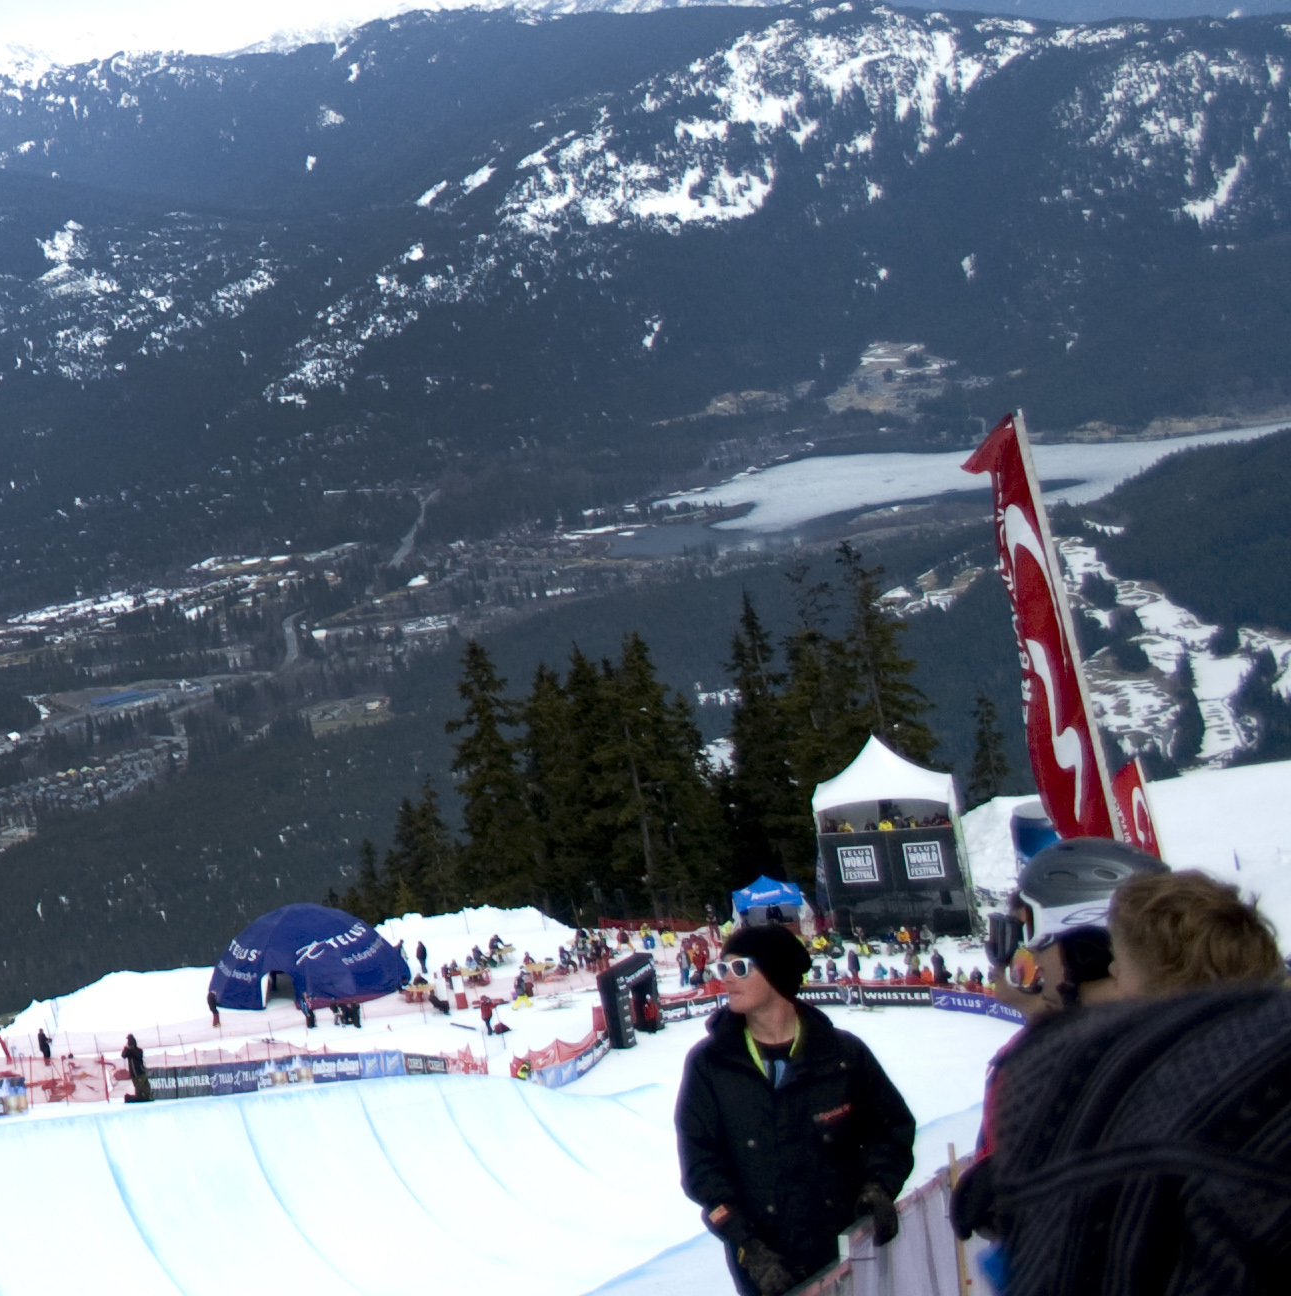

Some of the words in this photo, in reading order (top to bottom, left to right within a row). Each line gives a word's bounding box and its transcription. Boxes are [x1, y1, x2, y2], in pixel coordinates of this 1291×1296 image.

[907, 845, 936, 853] TELUS
[843, 856, 872, 867] WORLD
[908, 852, 938, 864] WORLD
[863, 991, 931, 1000] WHISTLER
[951, 997, 981, 1008] TELUS
